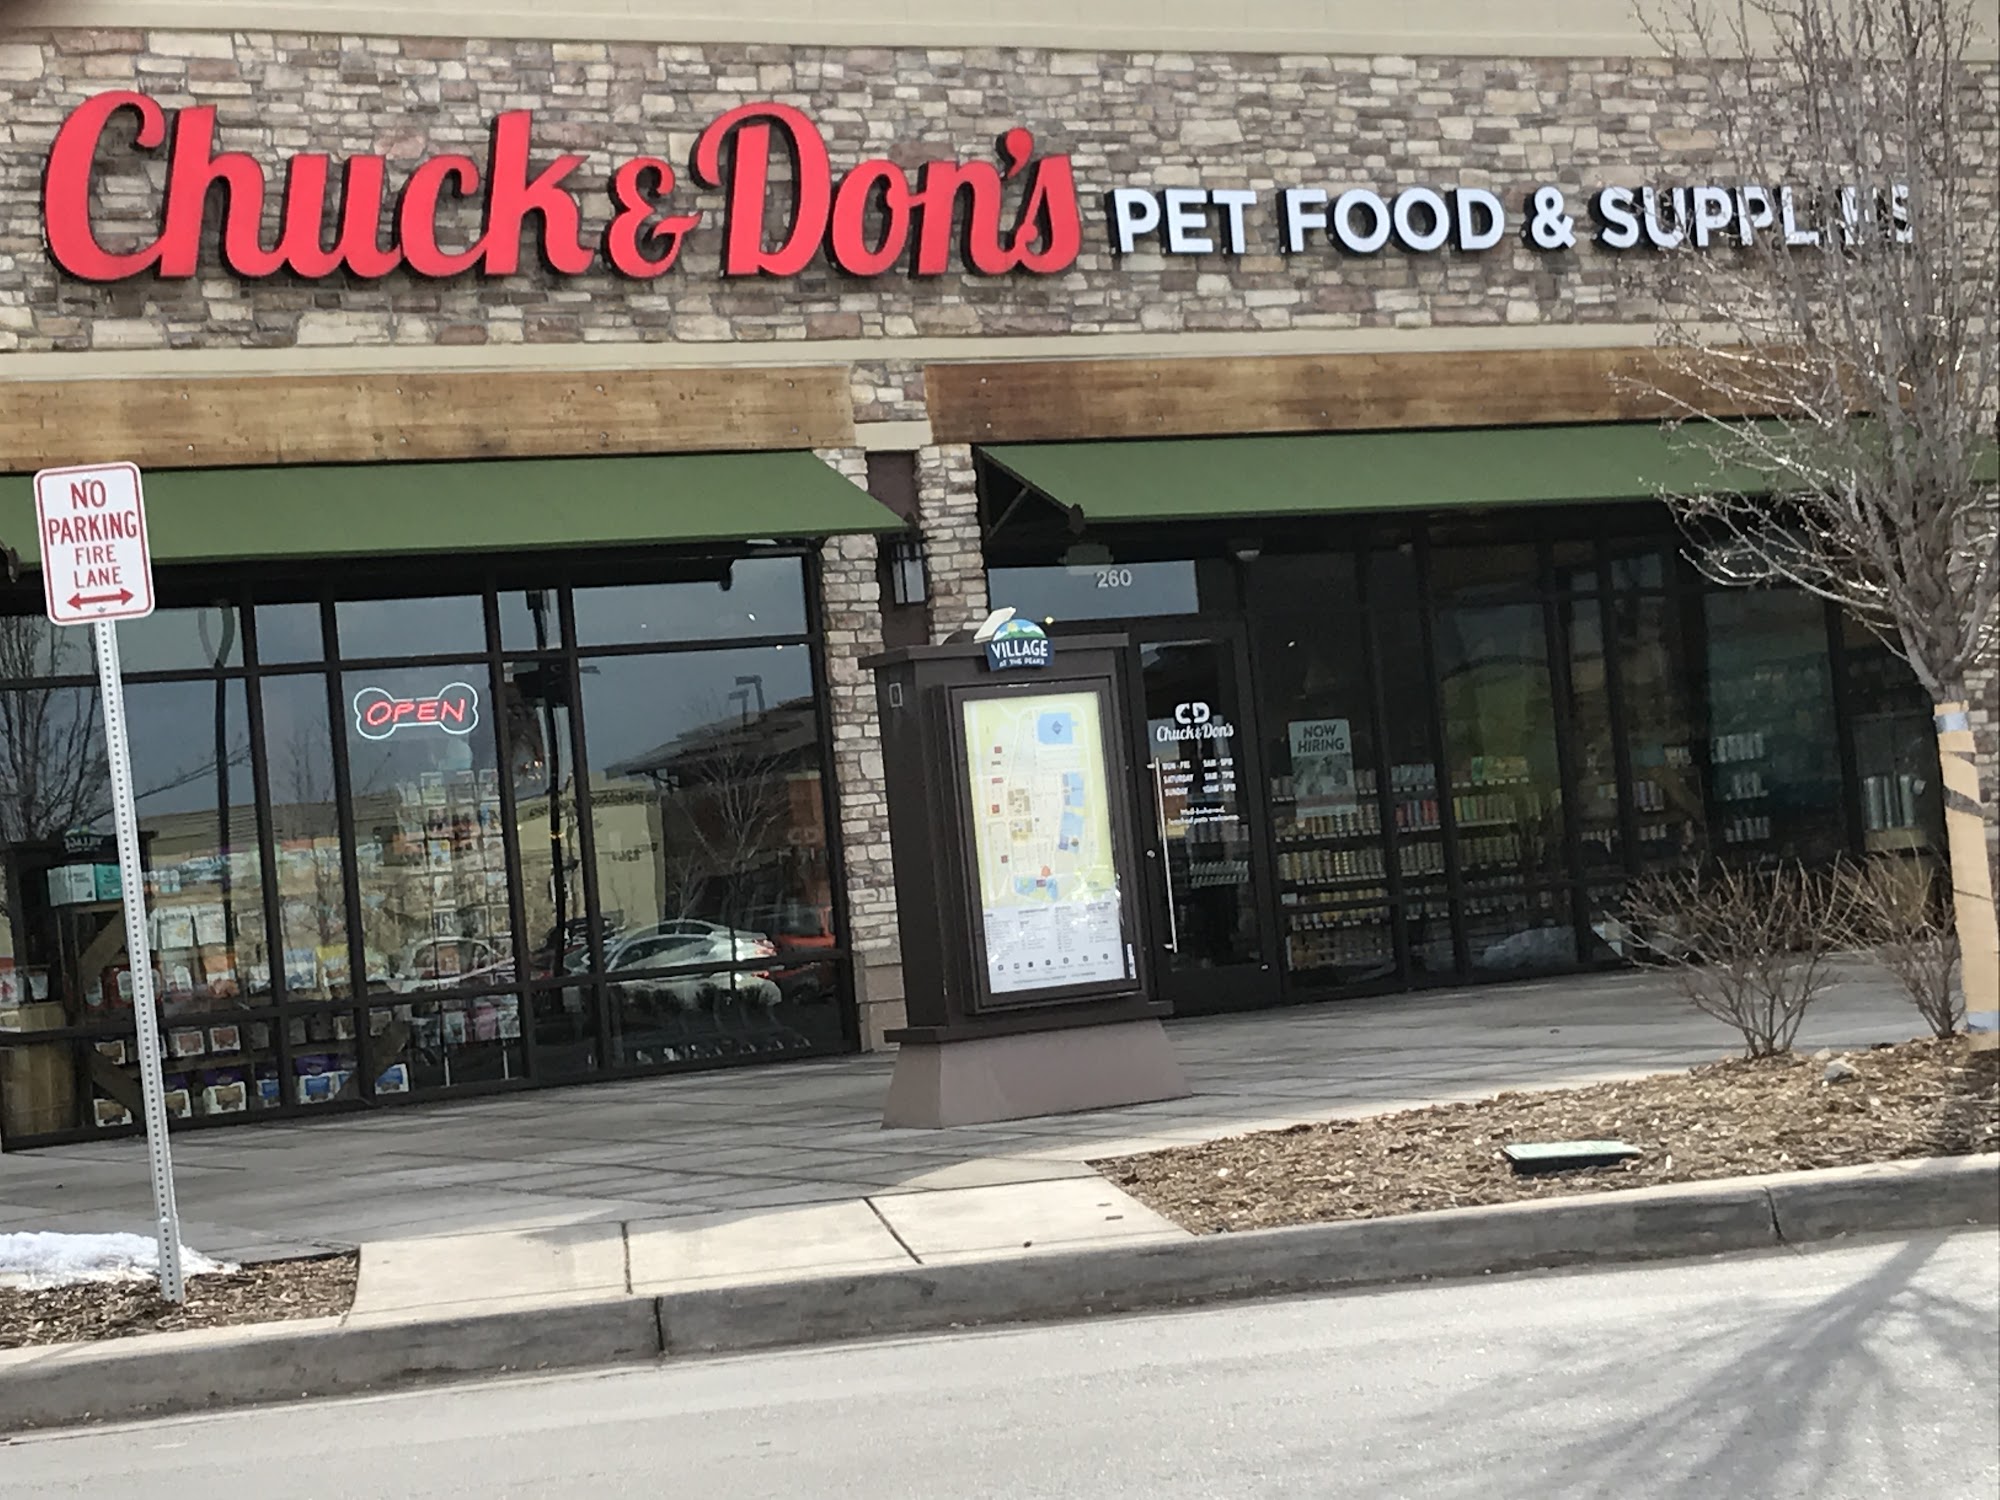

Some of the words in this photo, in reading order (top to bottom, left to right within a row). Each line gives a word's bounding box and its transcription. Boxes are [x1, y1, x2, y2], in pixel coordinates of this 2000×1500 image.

[43, 90, 595, 280] Chuck
[606, 156, 700, 278] &
[694, 101, 1081, 276] Don's
[1110, 188, 1258, 254] PET
[1284, 186, 1506, 254] FOOD
[1529, 185, 1577, 250] &
[1597, 185, 1915, 248] SUPPLS
[70, 479, 107, 510] NO
[48, 510, 137, 545] PARKING
[75, 544, 117, 566] FIRE
[74, 566, 123, 589] LANE
[1096, 568, 1132, 588] 260
[991, 639, 1048, 659] VILLAGE
[1009, 658, 1022, 666] THE
[366, 698, 465, 726] OPEN
[1156, 725, 1194, 742] Chuck
[1303, 724, 1337, 739] NOW
[1297, 738, 1345, 753] HIRING
